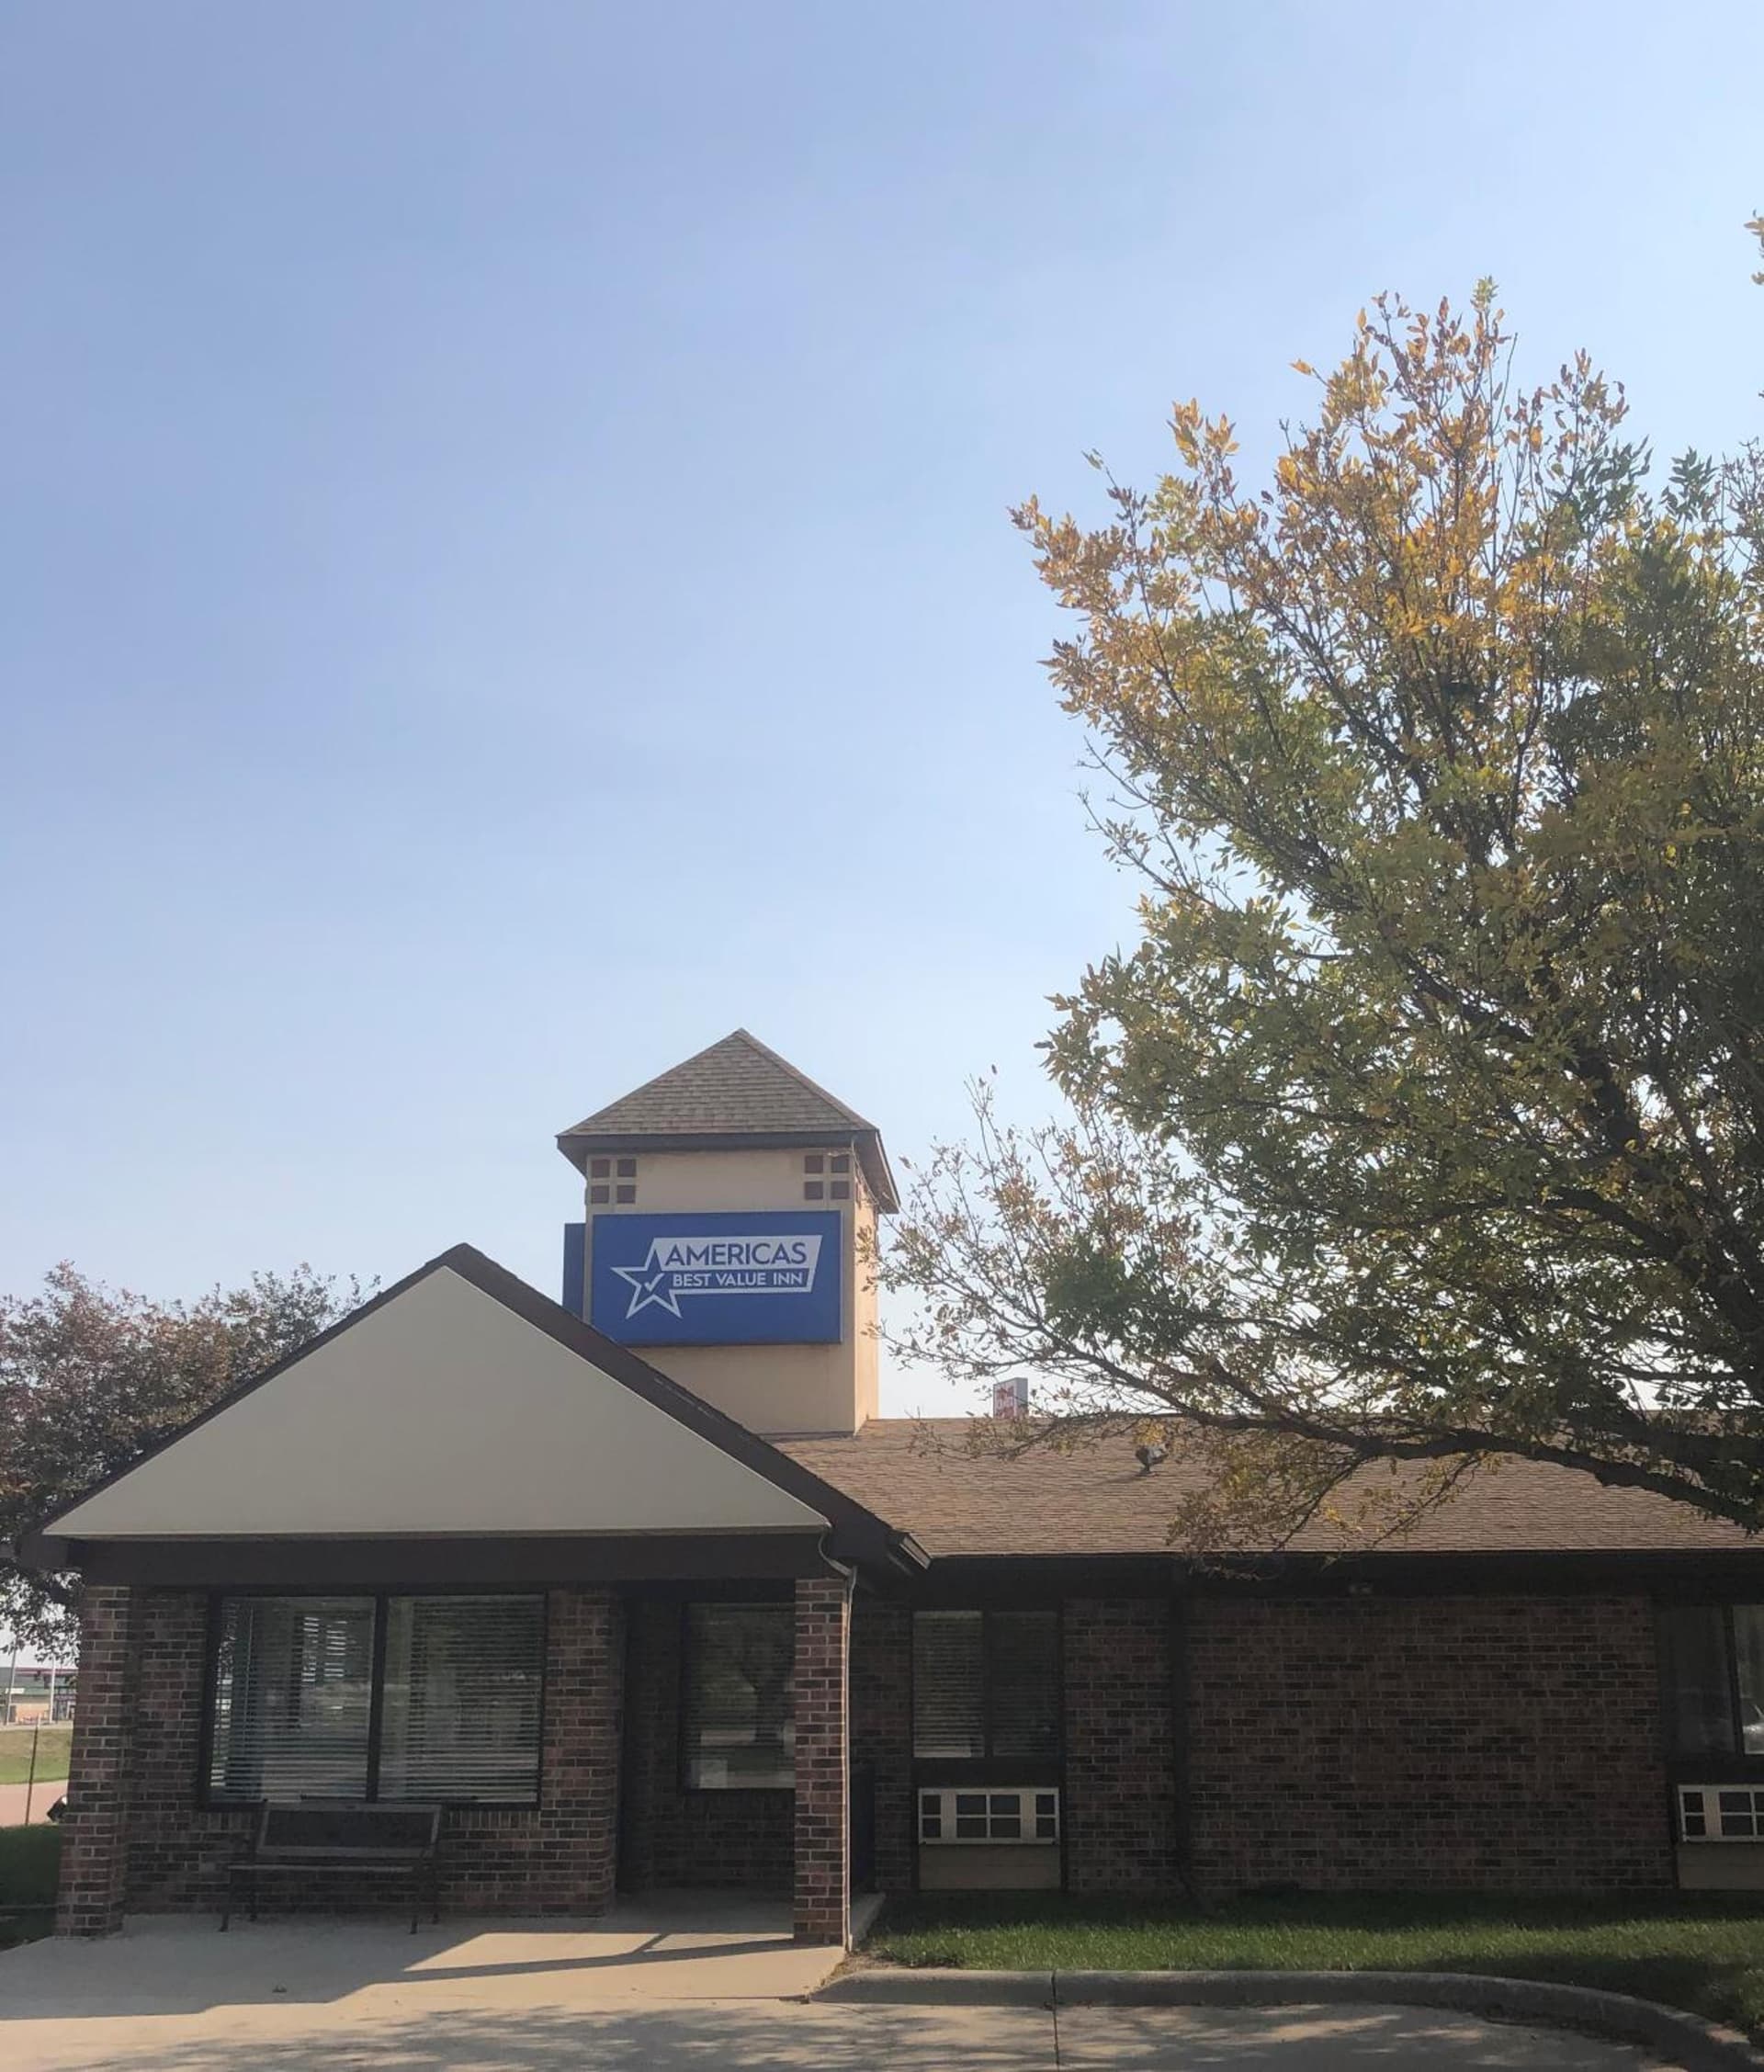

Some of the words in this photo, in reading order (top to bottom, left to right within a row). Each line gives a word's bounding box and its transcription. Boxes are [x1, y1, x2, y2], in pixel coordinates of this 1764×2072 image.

[665, 1242, 807, 1266] AMERICAS
[673, 1274, 712, 1287] BEST
[716, 1273, 766, 1286] VALUE
[774, 1272, 803, 1285] INN
